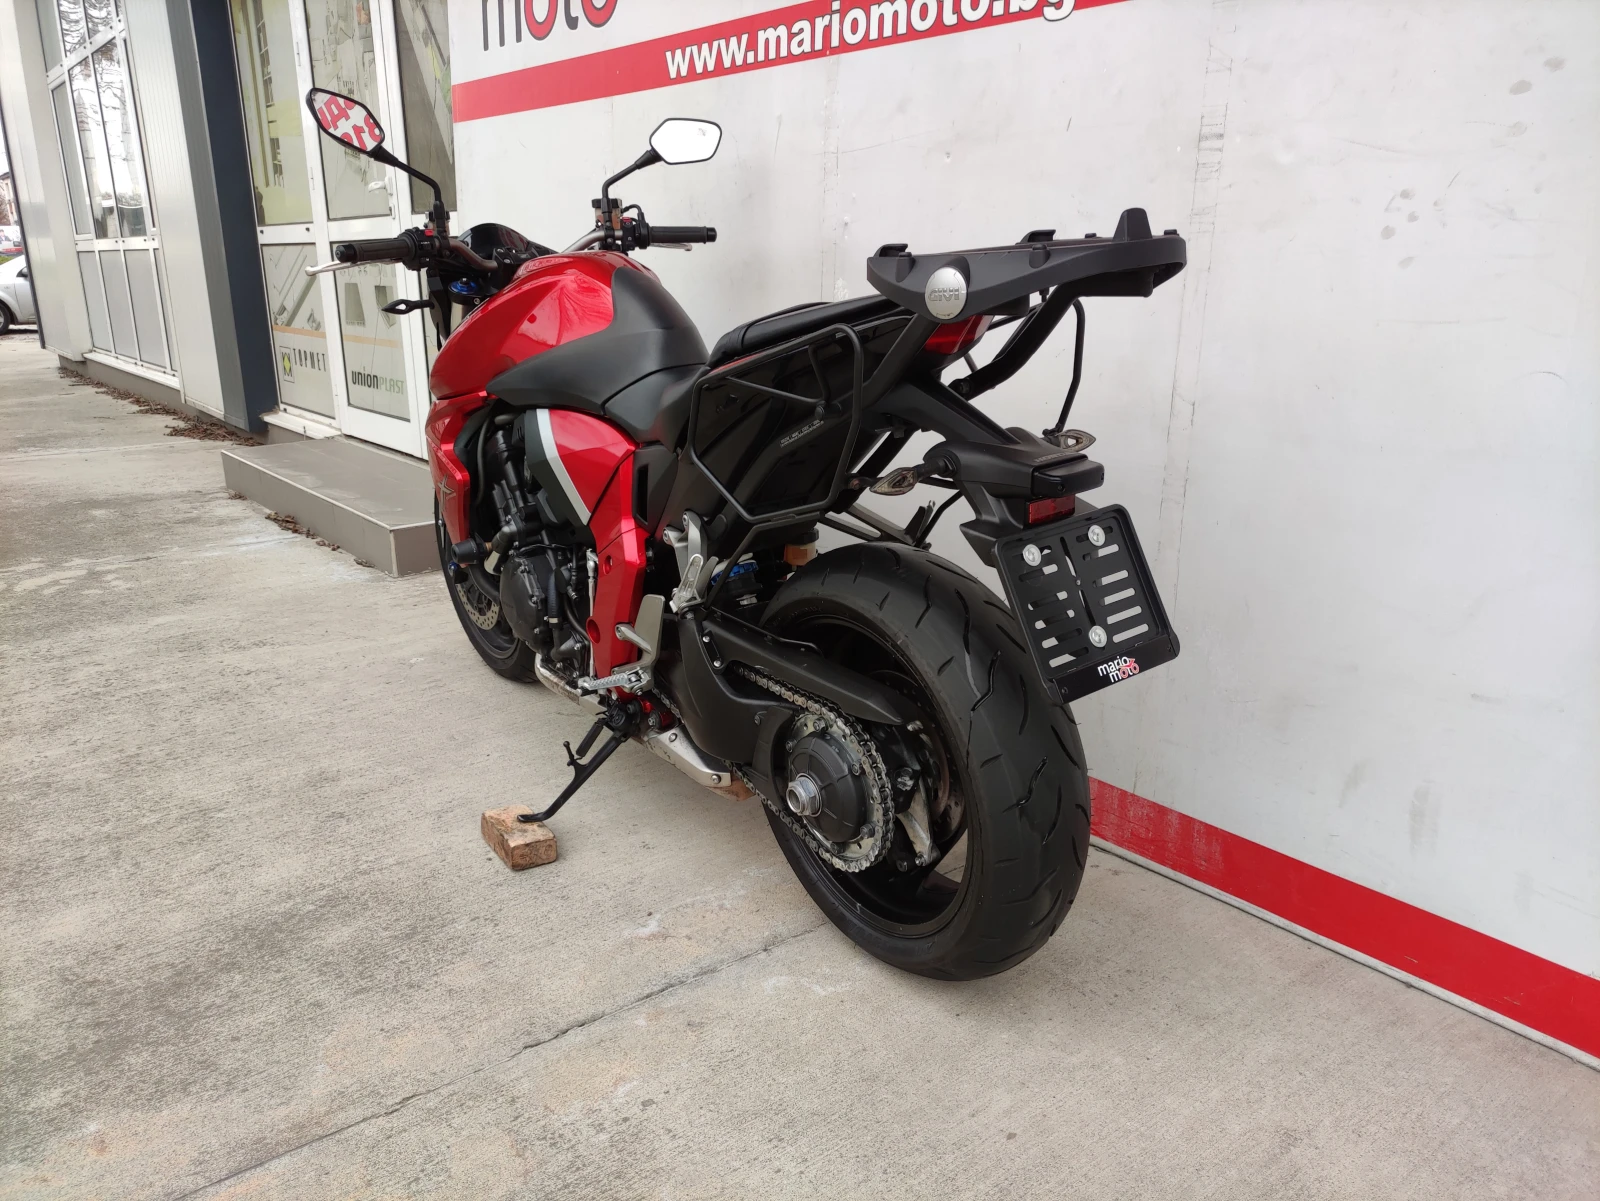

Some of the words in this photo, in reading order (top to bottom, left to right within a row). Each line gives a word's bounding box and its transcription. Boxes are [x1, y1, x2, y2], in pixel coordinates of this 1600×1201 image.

[664, 0, 1076, 79] www.mariomoto.
[928, 287, 960, 302] GIVI
[1097, 655, 1129, 677] mario
[1108, 662, 1140, 683] moto
